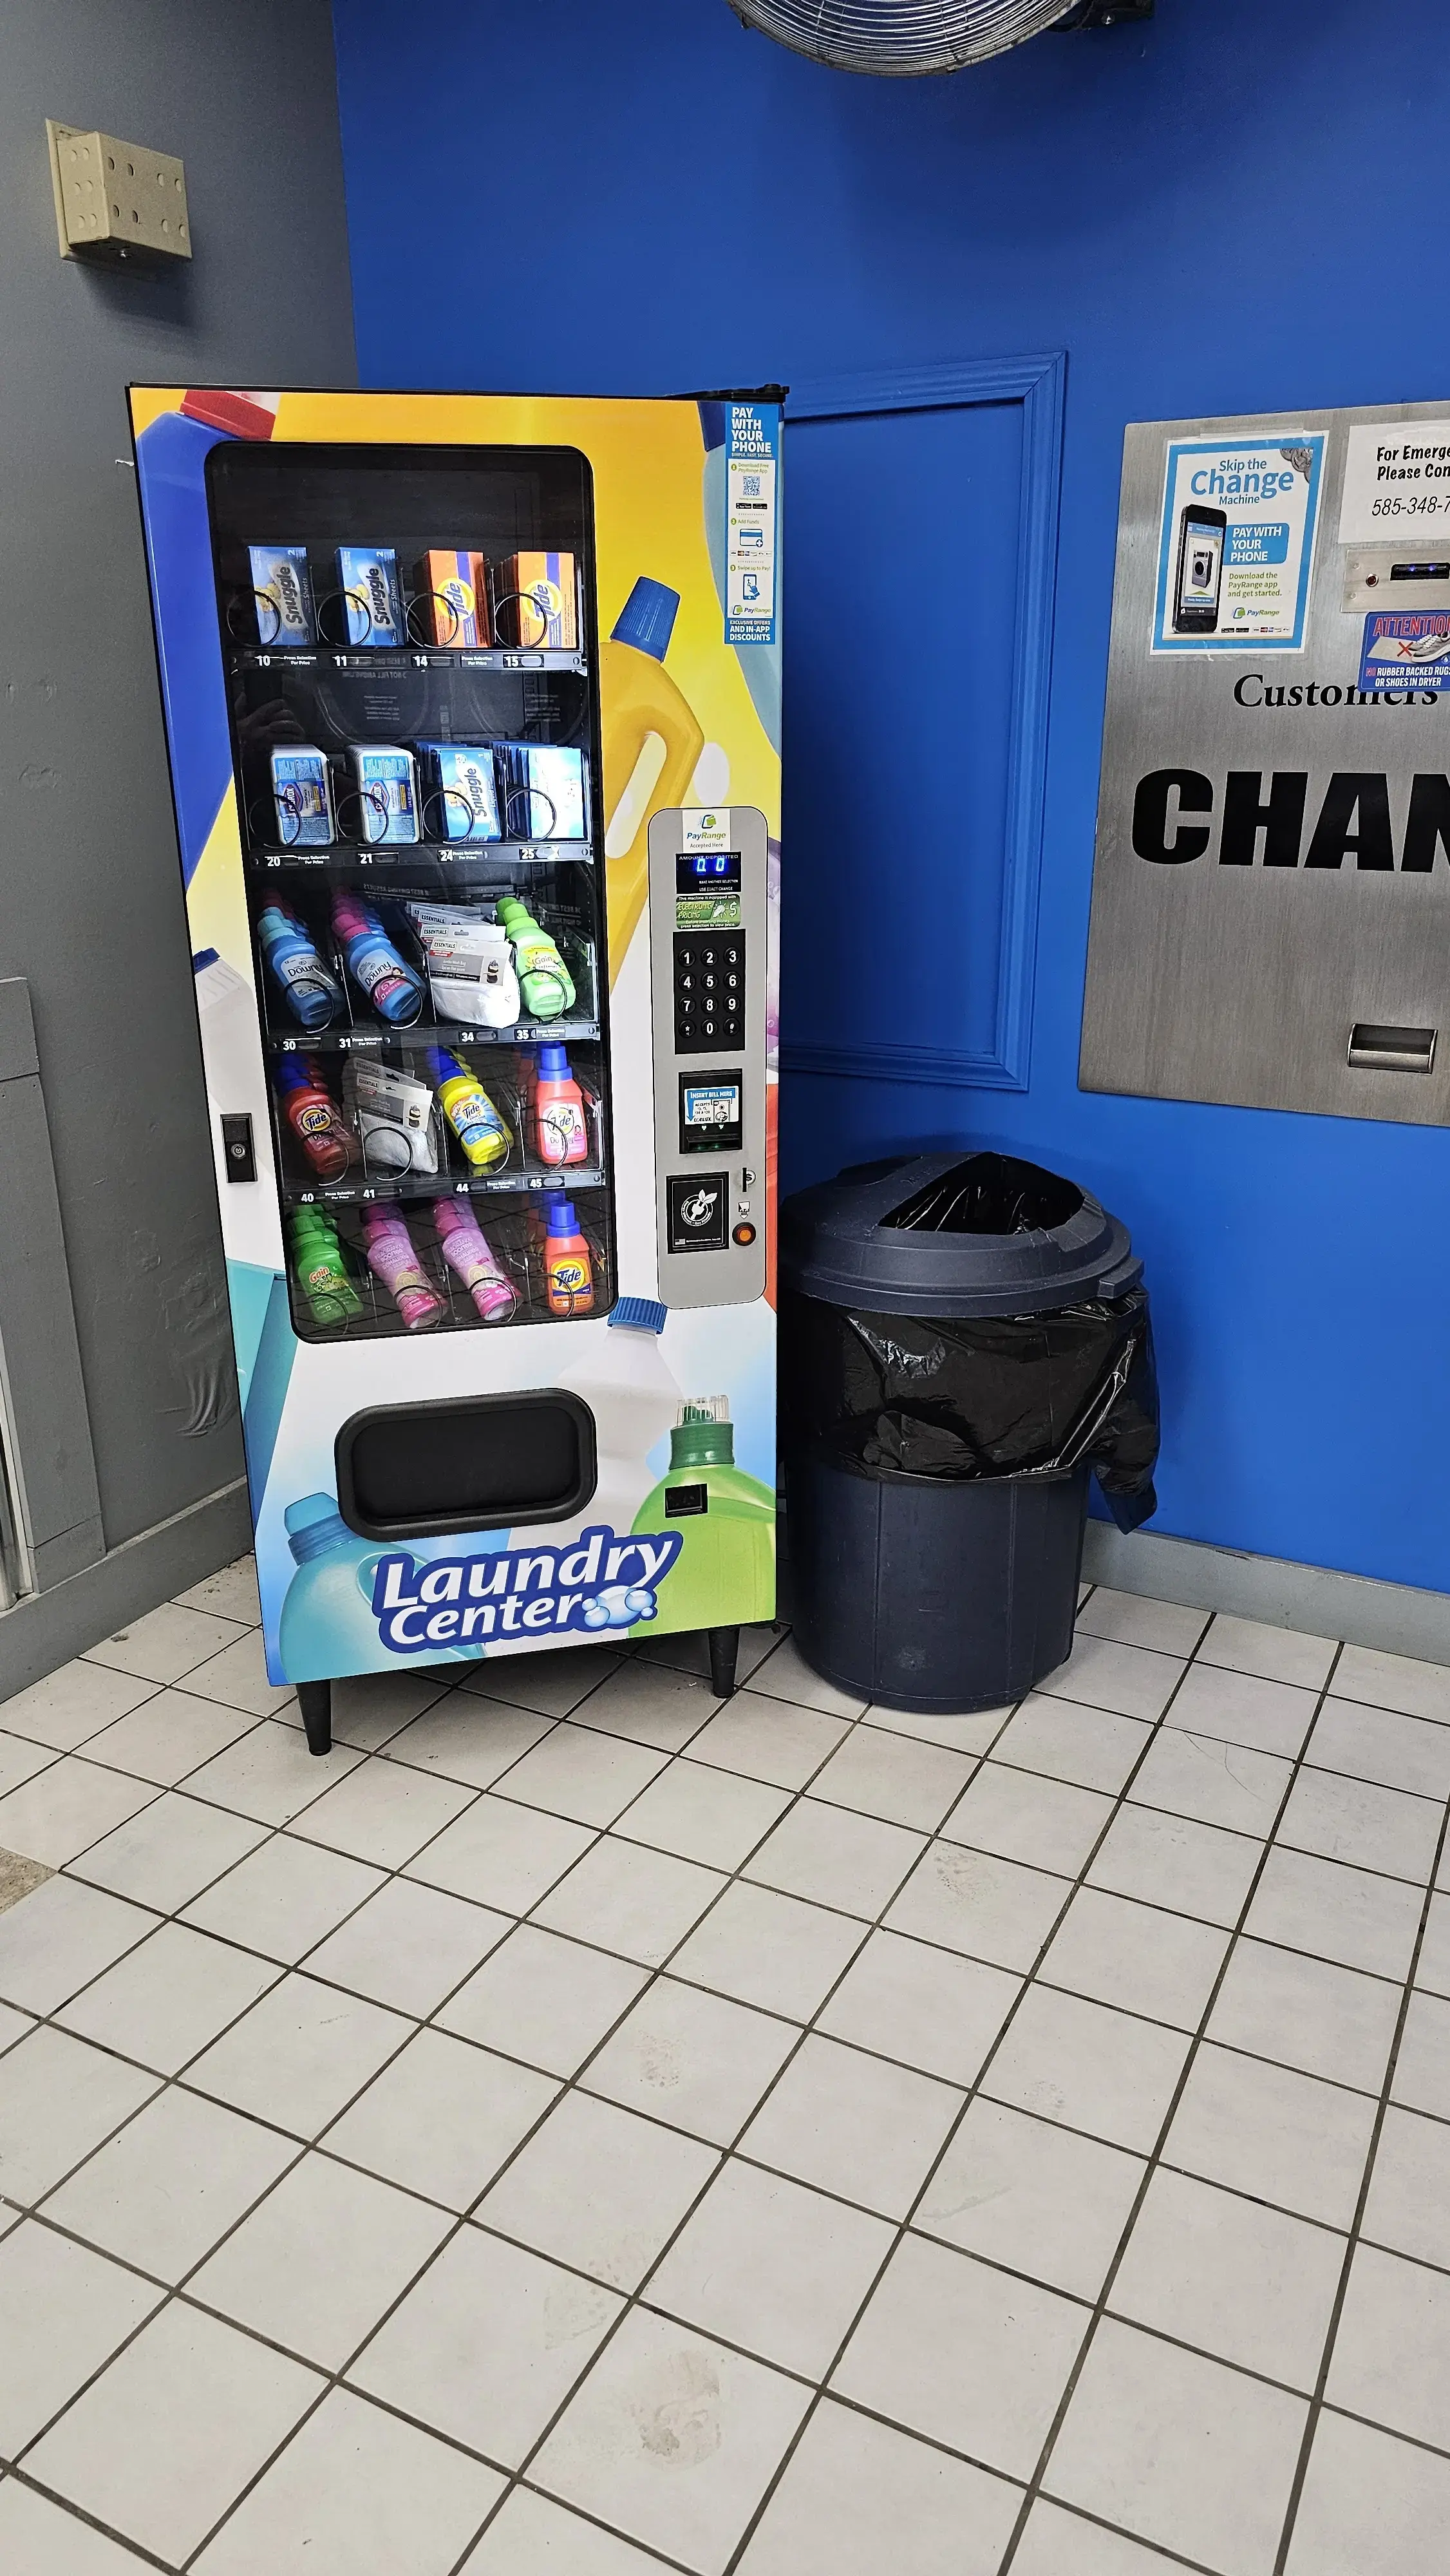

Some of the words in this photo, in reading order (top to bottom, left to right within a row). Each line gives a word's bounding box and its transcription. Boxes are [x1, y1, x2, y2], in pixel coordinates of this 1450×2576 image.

[732, 407, 753, 419] PAY
[731, 419, 762, 430] WITH
[731, 430, 763, 441] YOUR
[731, 441, 771, 453] PHONE
[1377, 447, 1399, 462] For
[1219, 459, 1245, 473] Skip
[1248, 459, 1267, 469] the
[1377, 466, 1420, 480] Please
[1425, 464, 1450, 477] Con
[1191, 469, 1294, 499] Change
[1219, 494, 1260, 505] Machine
[1372, 496, 1450, 516] 585-348-7
[1233, 527, 1256, 538] PAY
[1254, 526, 1282, 536] WITH
[1232, 539, 1262, 549] YOUR
[1230, 551, 1268, 562] PHONE
[279, 567, 303, 625] Snuggle
[366, 568, 390, 625] Snuggle
[446, 582, 470, 616] Tide
[532, 584, 555, 617] Tide
[258, 656, 270, 666] 10
[335, 656, 347, 667] 11
[415, 655, 428, 667] 14
[507, 656, 519, 667] 15
[1366, 667, 1377, 676] NO
[1377, 667, 1404, 676] RUBBER
[1406, 667, 1435, 676] BACKED
[1435, 667, 1450, 676] RUG
[1375, 678, 1385, 687] OR
[1386, 678, 1408, 687] SHOES
[1409, 677, 1418, 687] IN
[1418, 677, 1442, 687] DRYER
[464, 768, 487, 817] Snuggle
[1132, 768, 1450, 873] CHAN
[686, 832, 726, 840] PayRange
[360, 854, 373, 864] 21
[440, 849, 453, 862] 24
[522, 849, 534, 859] 25
[267, 857, 281, 867] 20
[422, 914, 445, 923] ESSENTIALS
[684, 952, 690, 963] 1
[706, 952, 713, 963] 2
[729, 951, 737, 963] 3
[288, 965, 324, 977] Downy
[364, 961, 391, 987] Downy
[684, 976, 691, 988] 4
[706, 976, 713, 987] 5
[729, 975, 737, 987] 6
[684, 1001, 691, 1011] 7
[706, 999, 713, 1011] 8
[728, 998, 736, 1010] 9
[706, 1023, 713, 1034] 0
[461, 1032, 474, 1043] 34
[516, 1030, 529, 1040] 35
[283, 1041, 296, 1050] 30
[339, 1038, 351, 1048] 31
[356, 1063, 379, 1074] ESSENTIALS
[359, 1079, 378, 1088] ESSENTIALS
[462, 1105, 480, 1119] Tide
[305, 1114, 326, 1130] Tide
[456, 1183, 469, 1193] 44
[530, 1179, 542, 1188] 45
[301, 1193, 314, 1202] 40
[363, 1189, 375, 1198] 41
[309, 1267, 330, 1283] Gain
[557, 1269, 581, 1287] Tide
[382, 1534, 673, 1610] Laundry
[390, 1593, 585, 1644] Center
